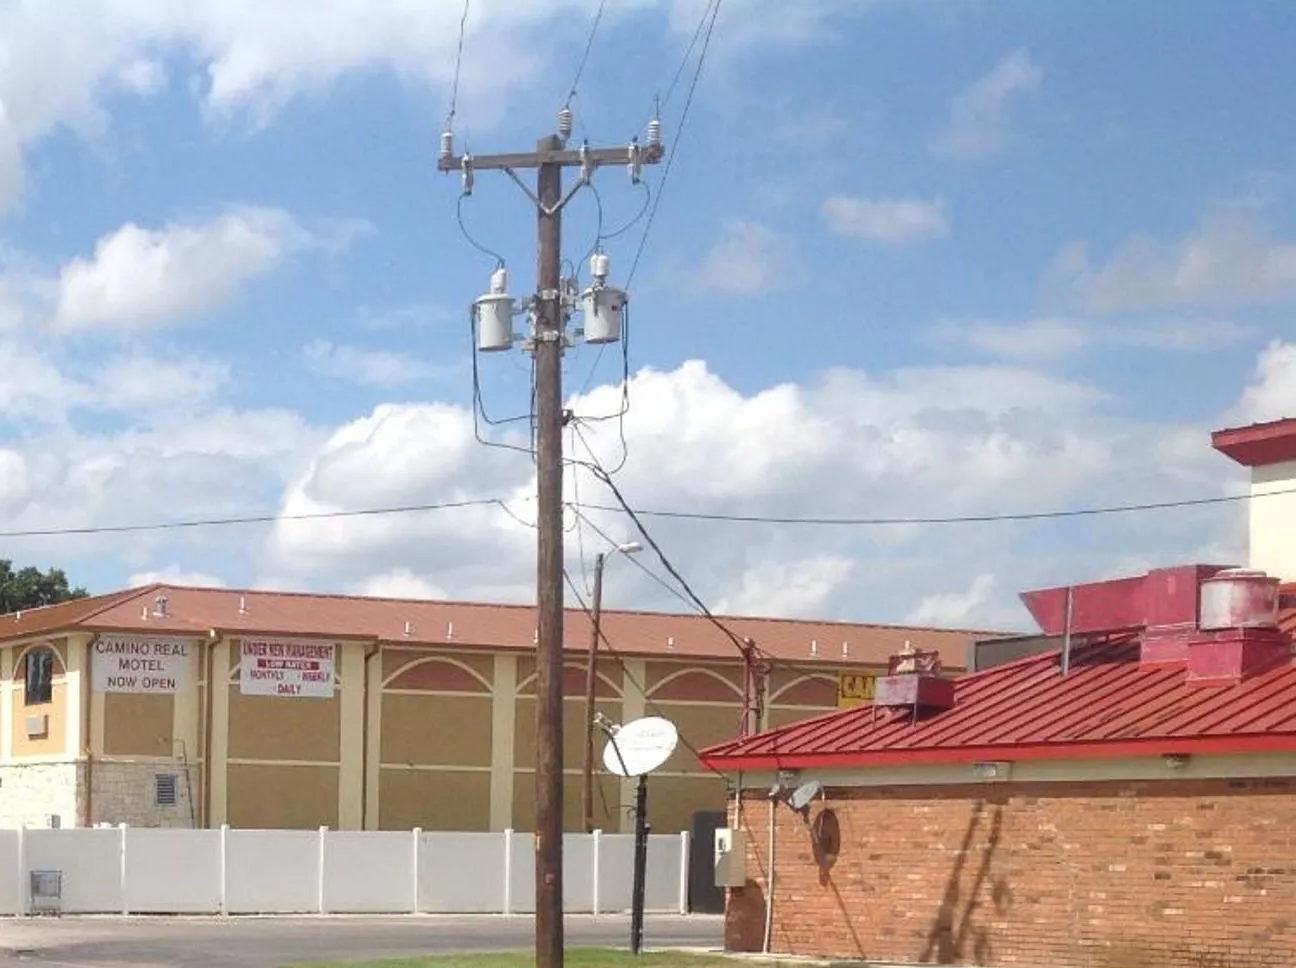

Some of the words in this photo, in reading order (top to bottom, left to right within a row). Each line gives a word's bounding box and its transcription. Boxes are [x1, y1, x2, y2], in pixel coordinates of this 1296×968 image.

[96, 641, 149, 655] CAMINO
[154, 643, 188, 656] REAL
[119, 658, 165, 671] MOTEL
[107, 676, 137, 688] NOW
[142, 677, 175, 689] OPEN
[278, 683, 301, 694] DAILY
